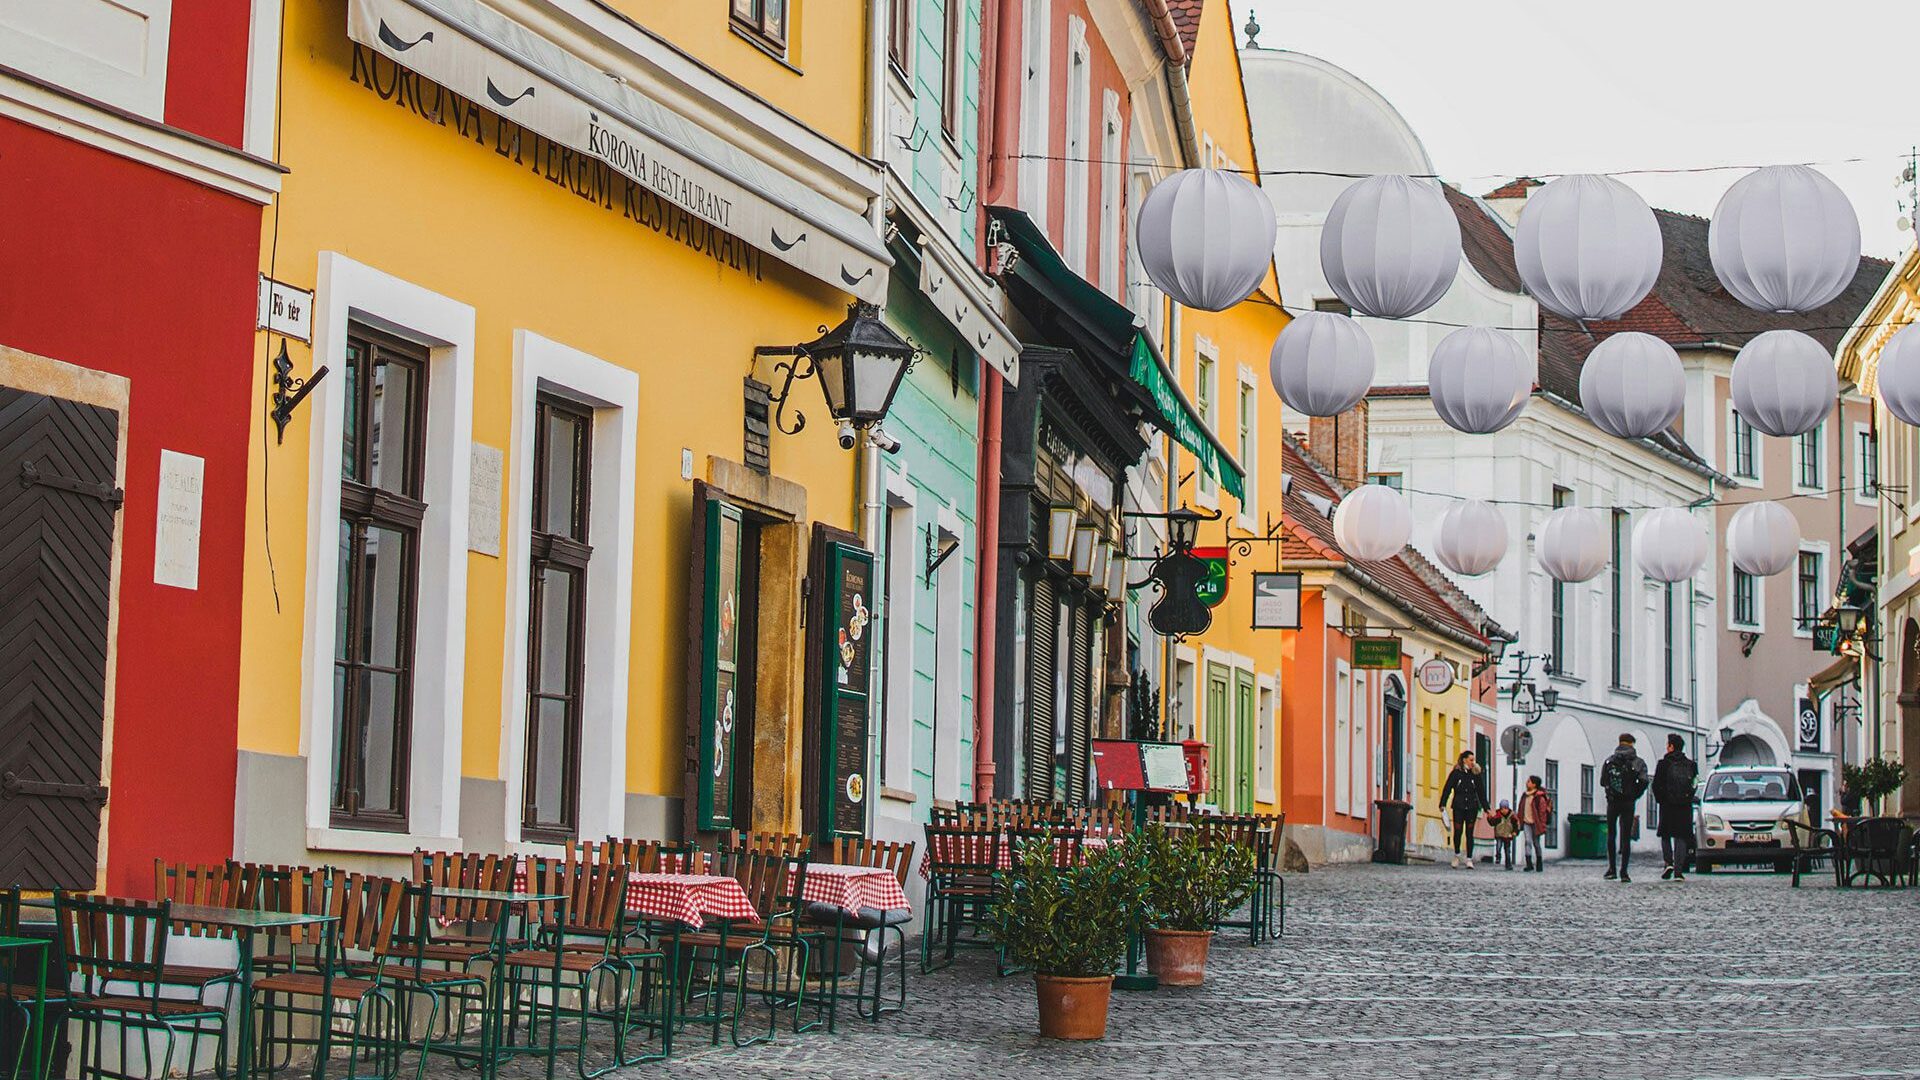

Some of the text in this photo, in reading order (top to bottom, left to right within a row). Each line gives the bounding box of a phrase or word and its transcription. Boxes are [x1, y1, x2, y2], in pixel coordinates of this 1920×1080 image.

[588, 122, 732, 227] KORONA RESTAURANT
[288, 299, 301, 321] tér
